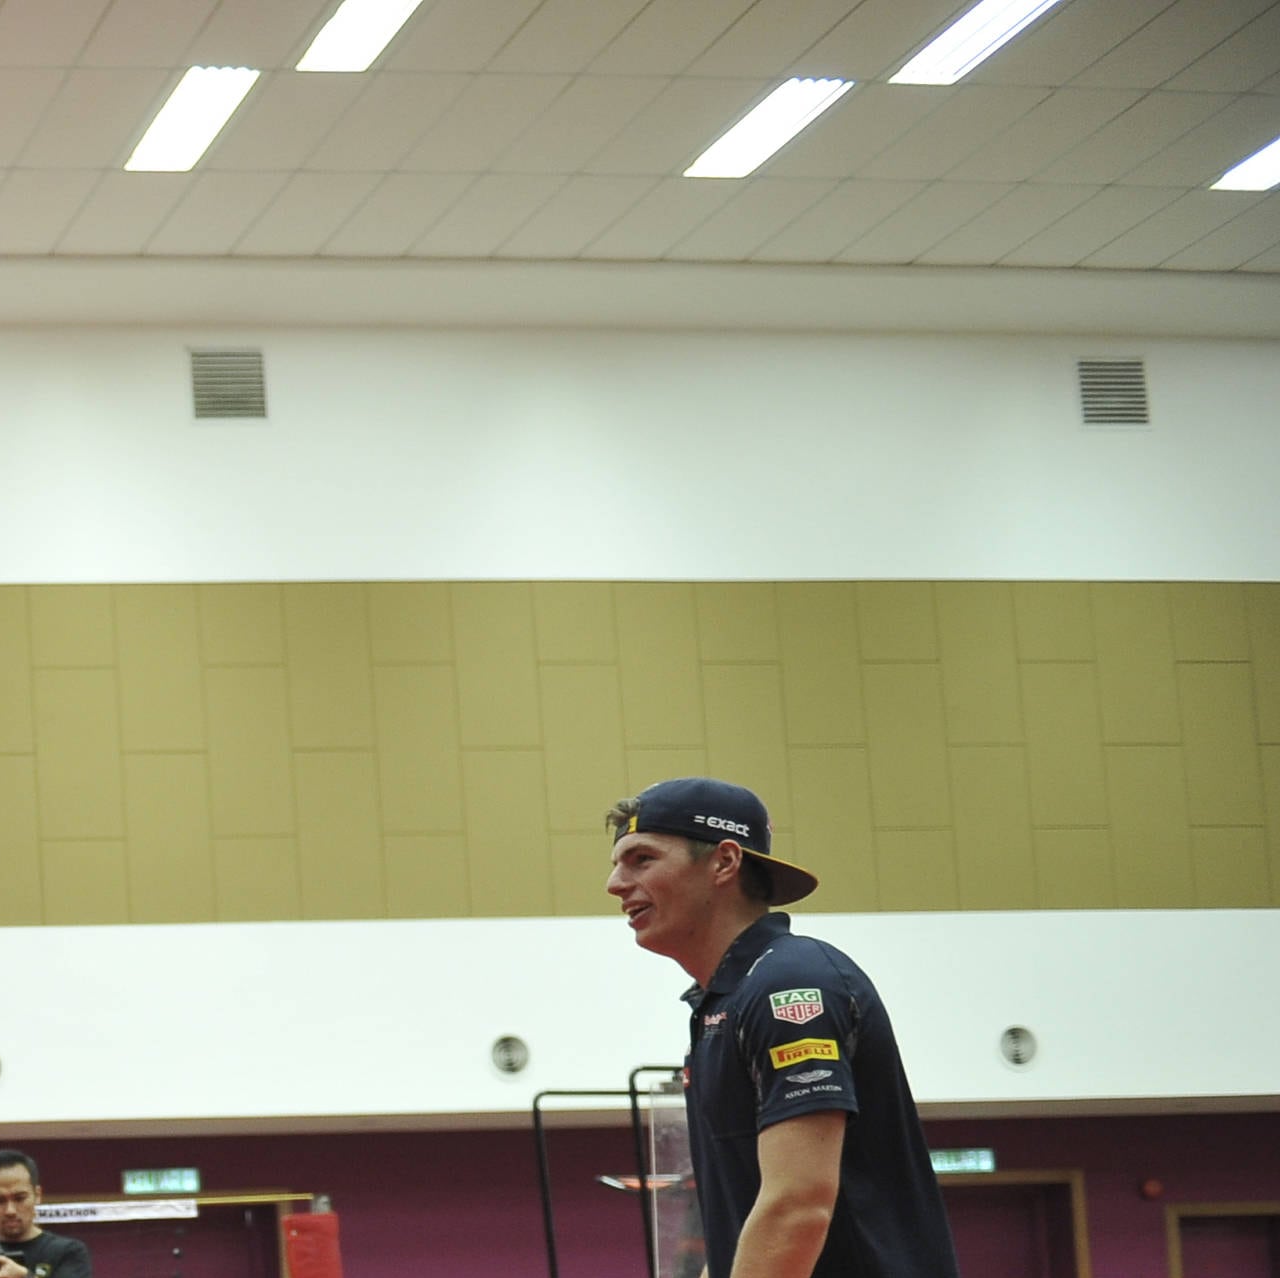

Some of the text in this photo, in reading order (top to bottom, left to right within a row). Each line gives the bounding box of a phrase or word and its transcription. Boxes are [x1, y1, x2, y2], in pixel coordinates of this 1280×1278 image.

[706, 816, 750, 837] exact
[775, 991, 818, 1005] TAG
[776, 1004, 821, 1020] HEUER
[777, 1043, 833, 1062] PIRELLI
[784, 1084, 843, 1100] ASTON MARTIN
[38, 1208, 97, 1217] MARATHON
